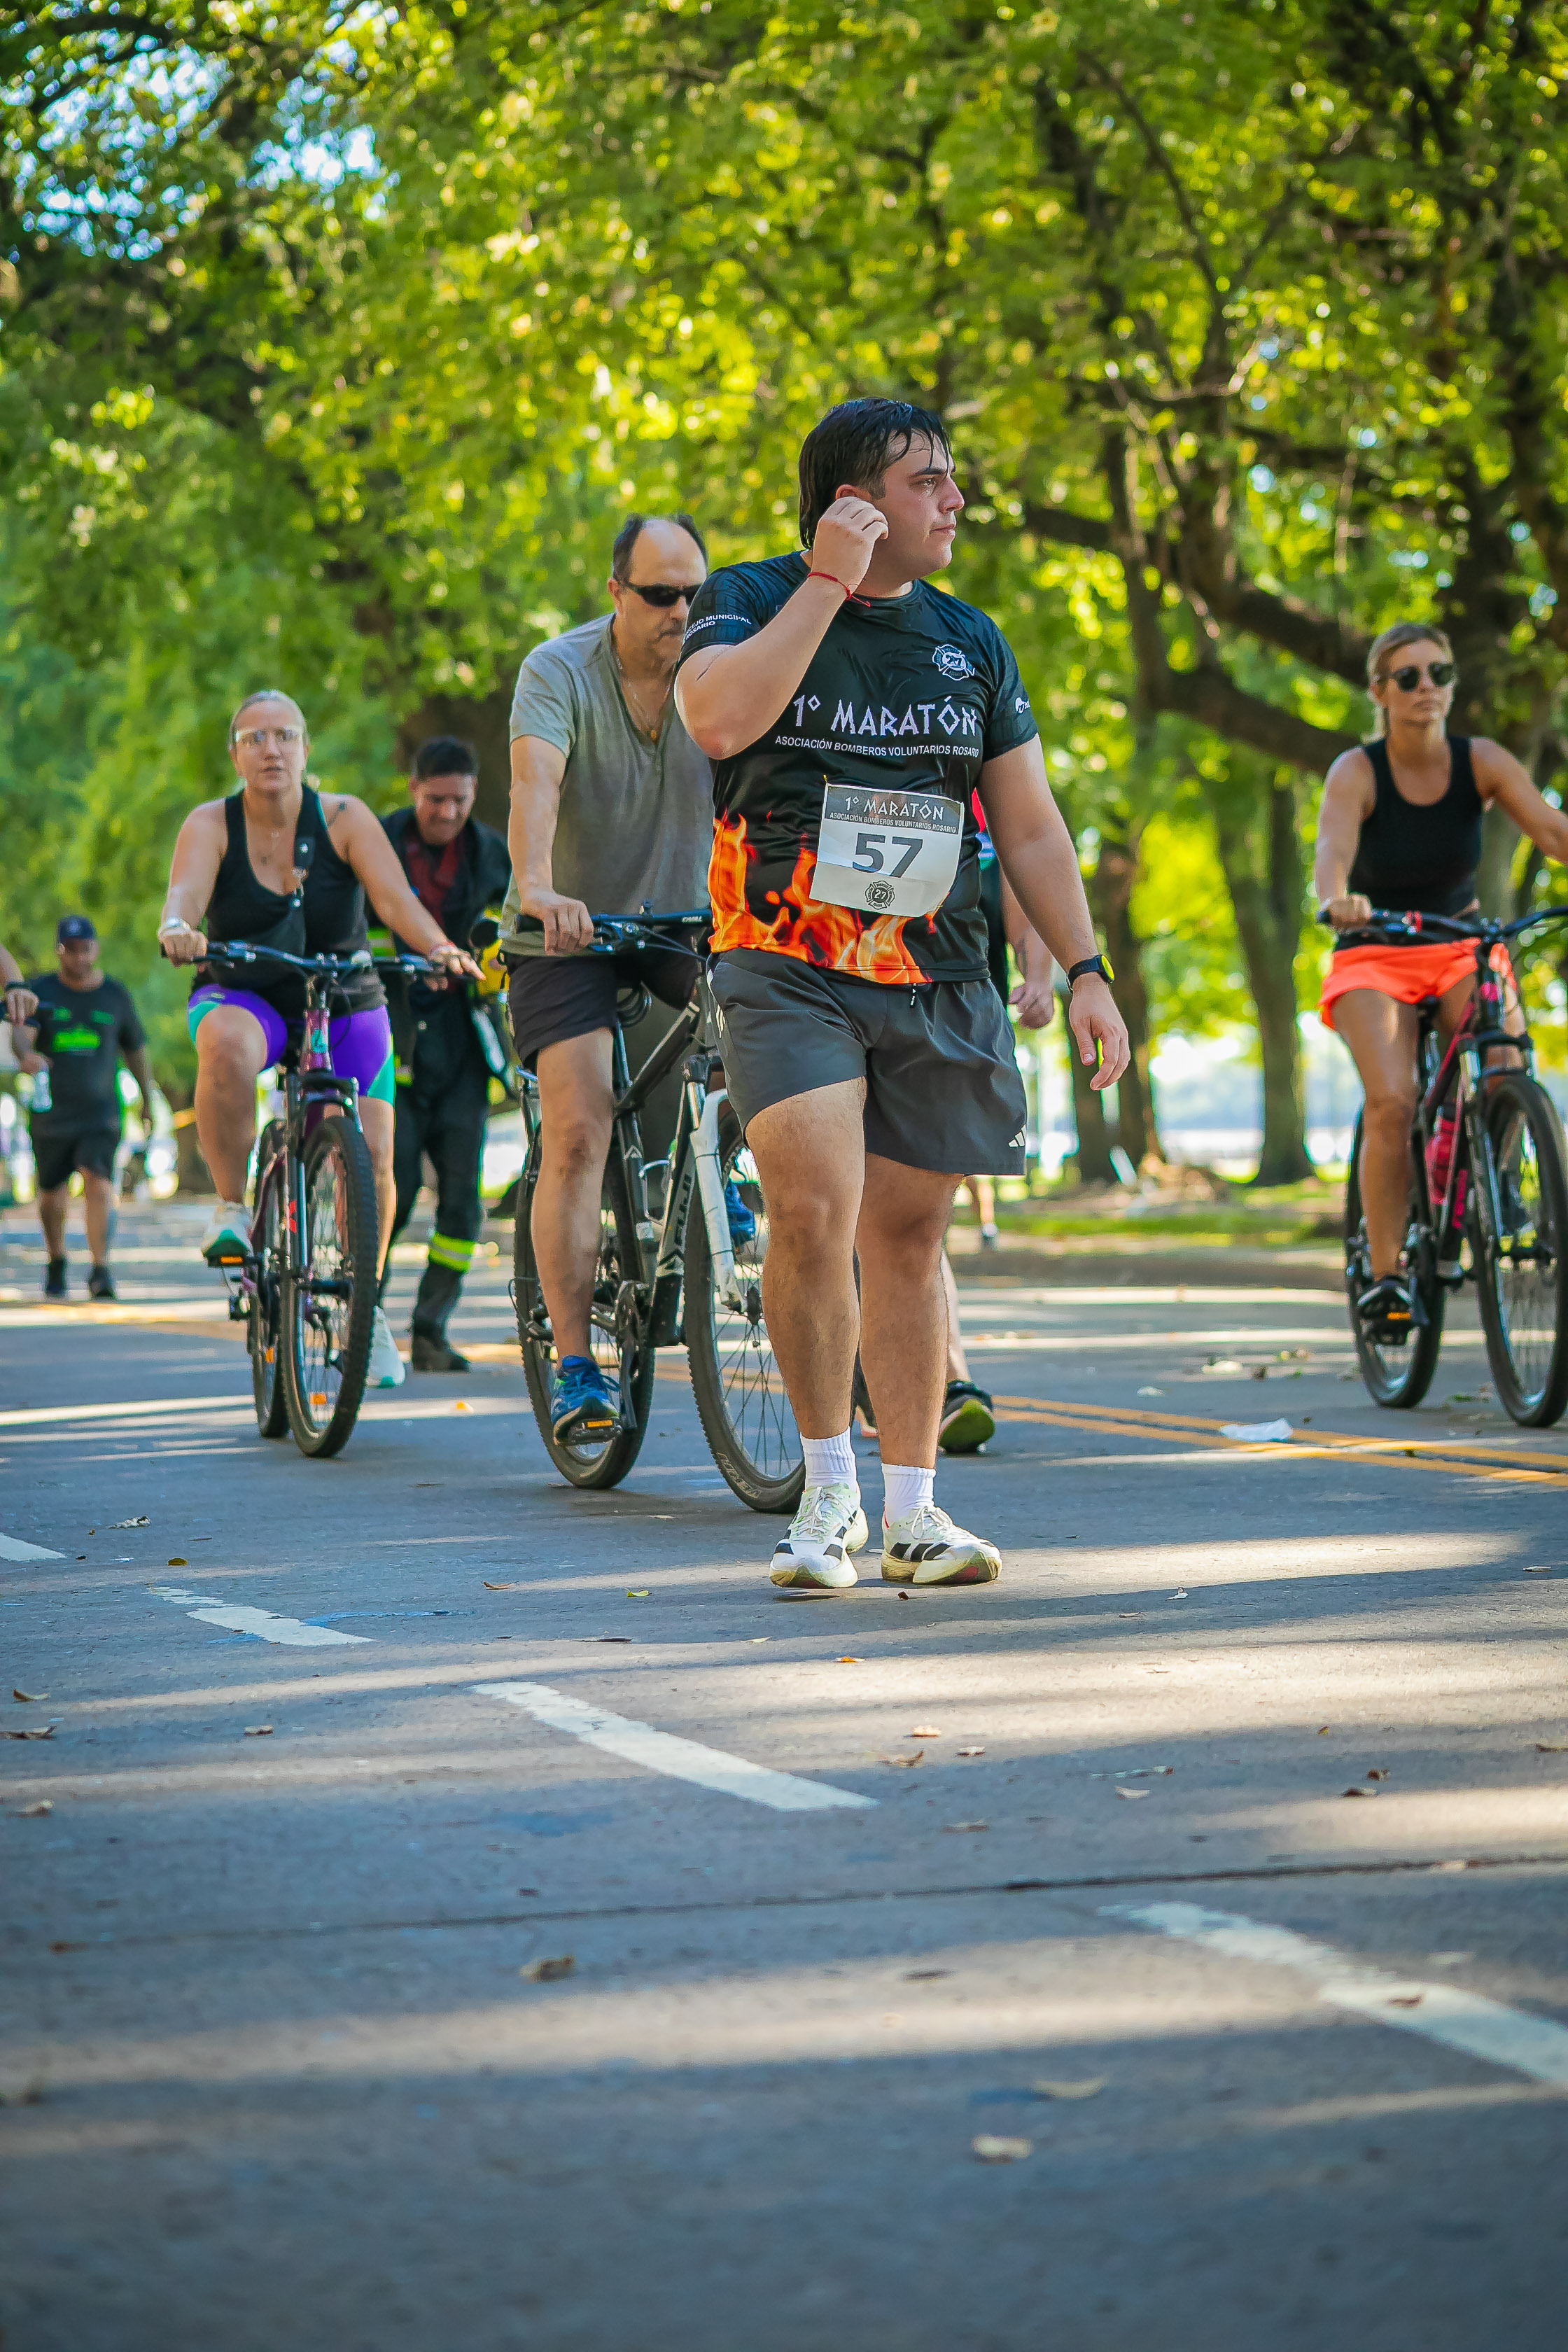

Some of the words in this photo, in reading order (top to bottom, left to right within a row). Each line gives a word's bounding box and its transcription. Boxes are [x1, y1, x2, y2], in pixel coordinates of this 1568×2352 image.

[830, 695, 977, 736] MARATÓN
[775, 735, 832, 750] ASOCIACIÓN
[834, 743, 887, 756] BOMBEROS
[888, 745, 950, 756] VOLUNTARIOS
[953, 746, 979, 758] ROSARIO
[863, 799, 944, 821] MARATÓN
[830, 812, 862, 823] ASOCIACIÓN
[863, 816, 894, 826] BOMBEROS
[895, 820, 932, 830] VOLUNTARIOS
[932, 824, 956, 834] ROSARIO
[852, 832, 923, 878] 57
[874, 888, 887, 899] 27
